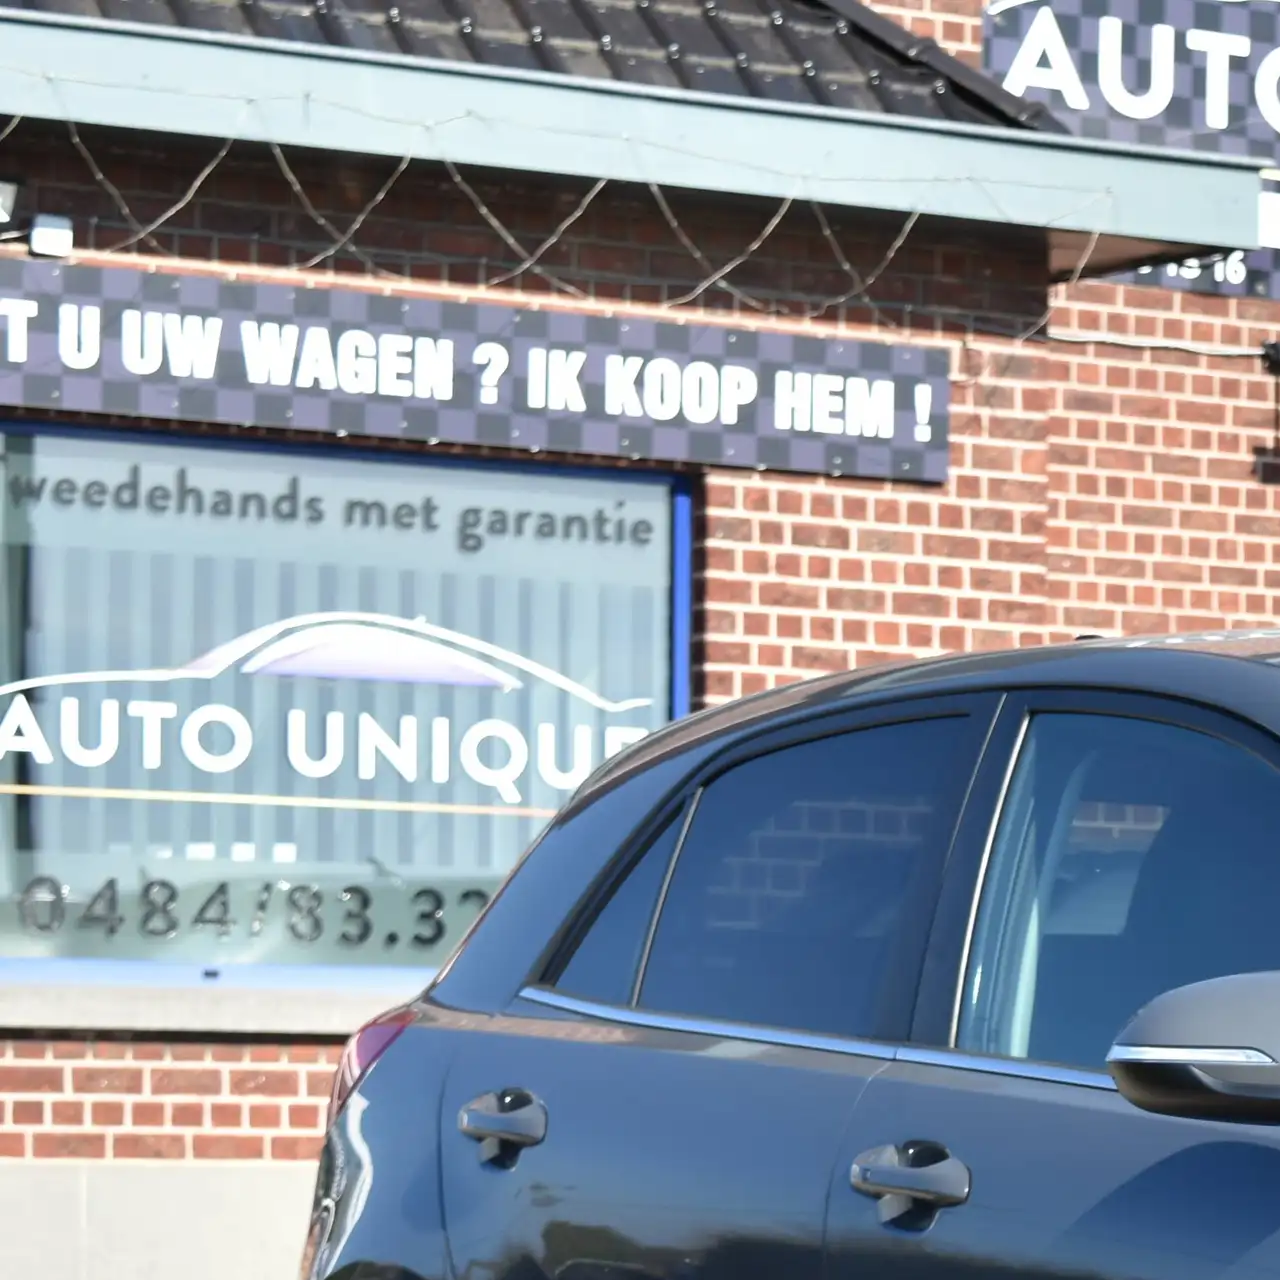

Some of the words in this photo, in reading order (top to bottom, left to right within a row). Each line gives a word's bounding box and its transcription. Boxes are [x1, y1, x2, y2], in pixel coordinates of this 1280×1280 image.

[58, 304, 100, 369] U
[121, 309, 223, 379] UW
[240, 320, 453, 400] WAGEN
[472, 342, 509, 404] ?
[527, 347, 587, 412] IK
[605, 354, 758, 424] KOOP
[775, 370, 895, 439] HEM
[0, 462, 325, 524] weedehands
[344, 497, 440, 533] met
[458, 502, 655, 553] garantie
[0, 694, 253, 774] AUTO
